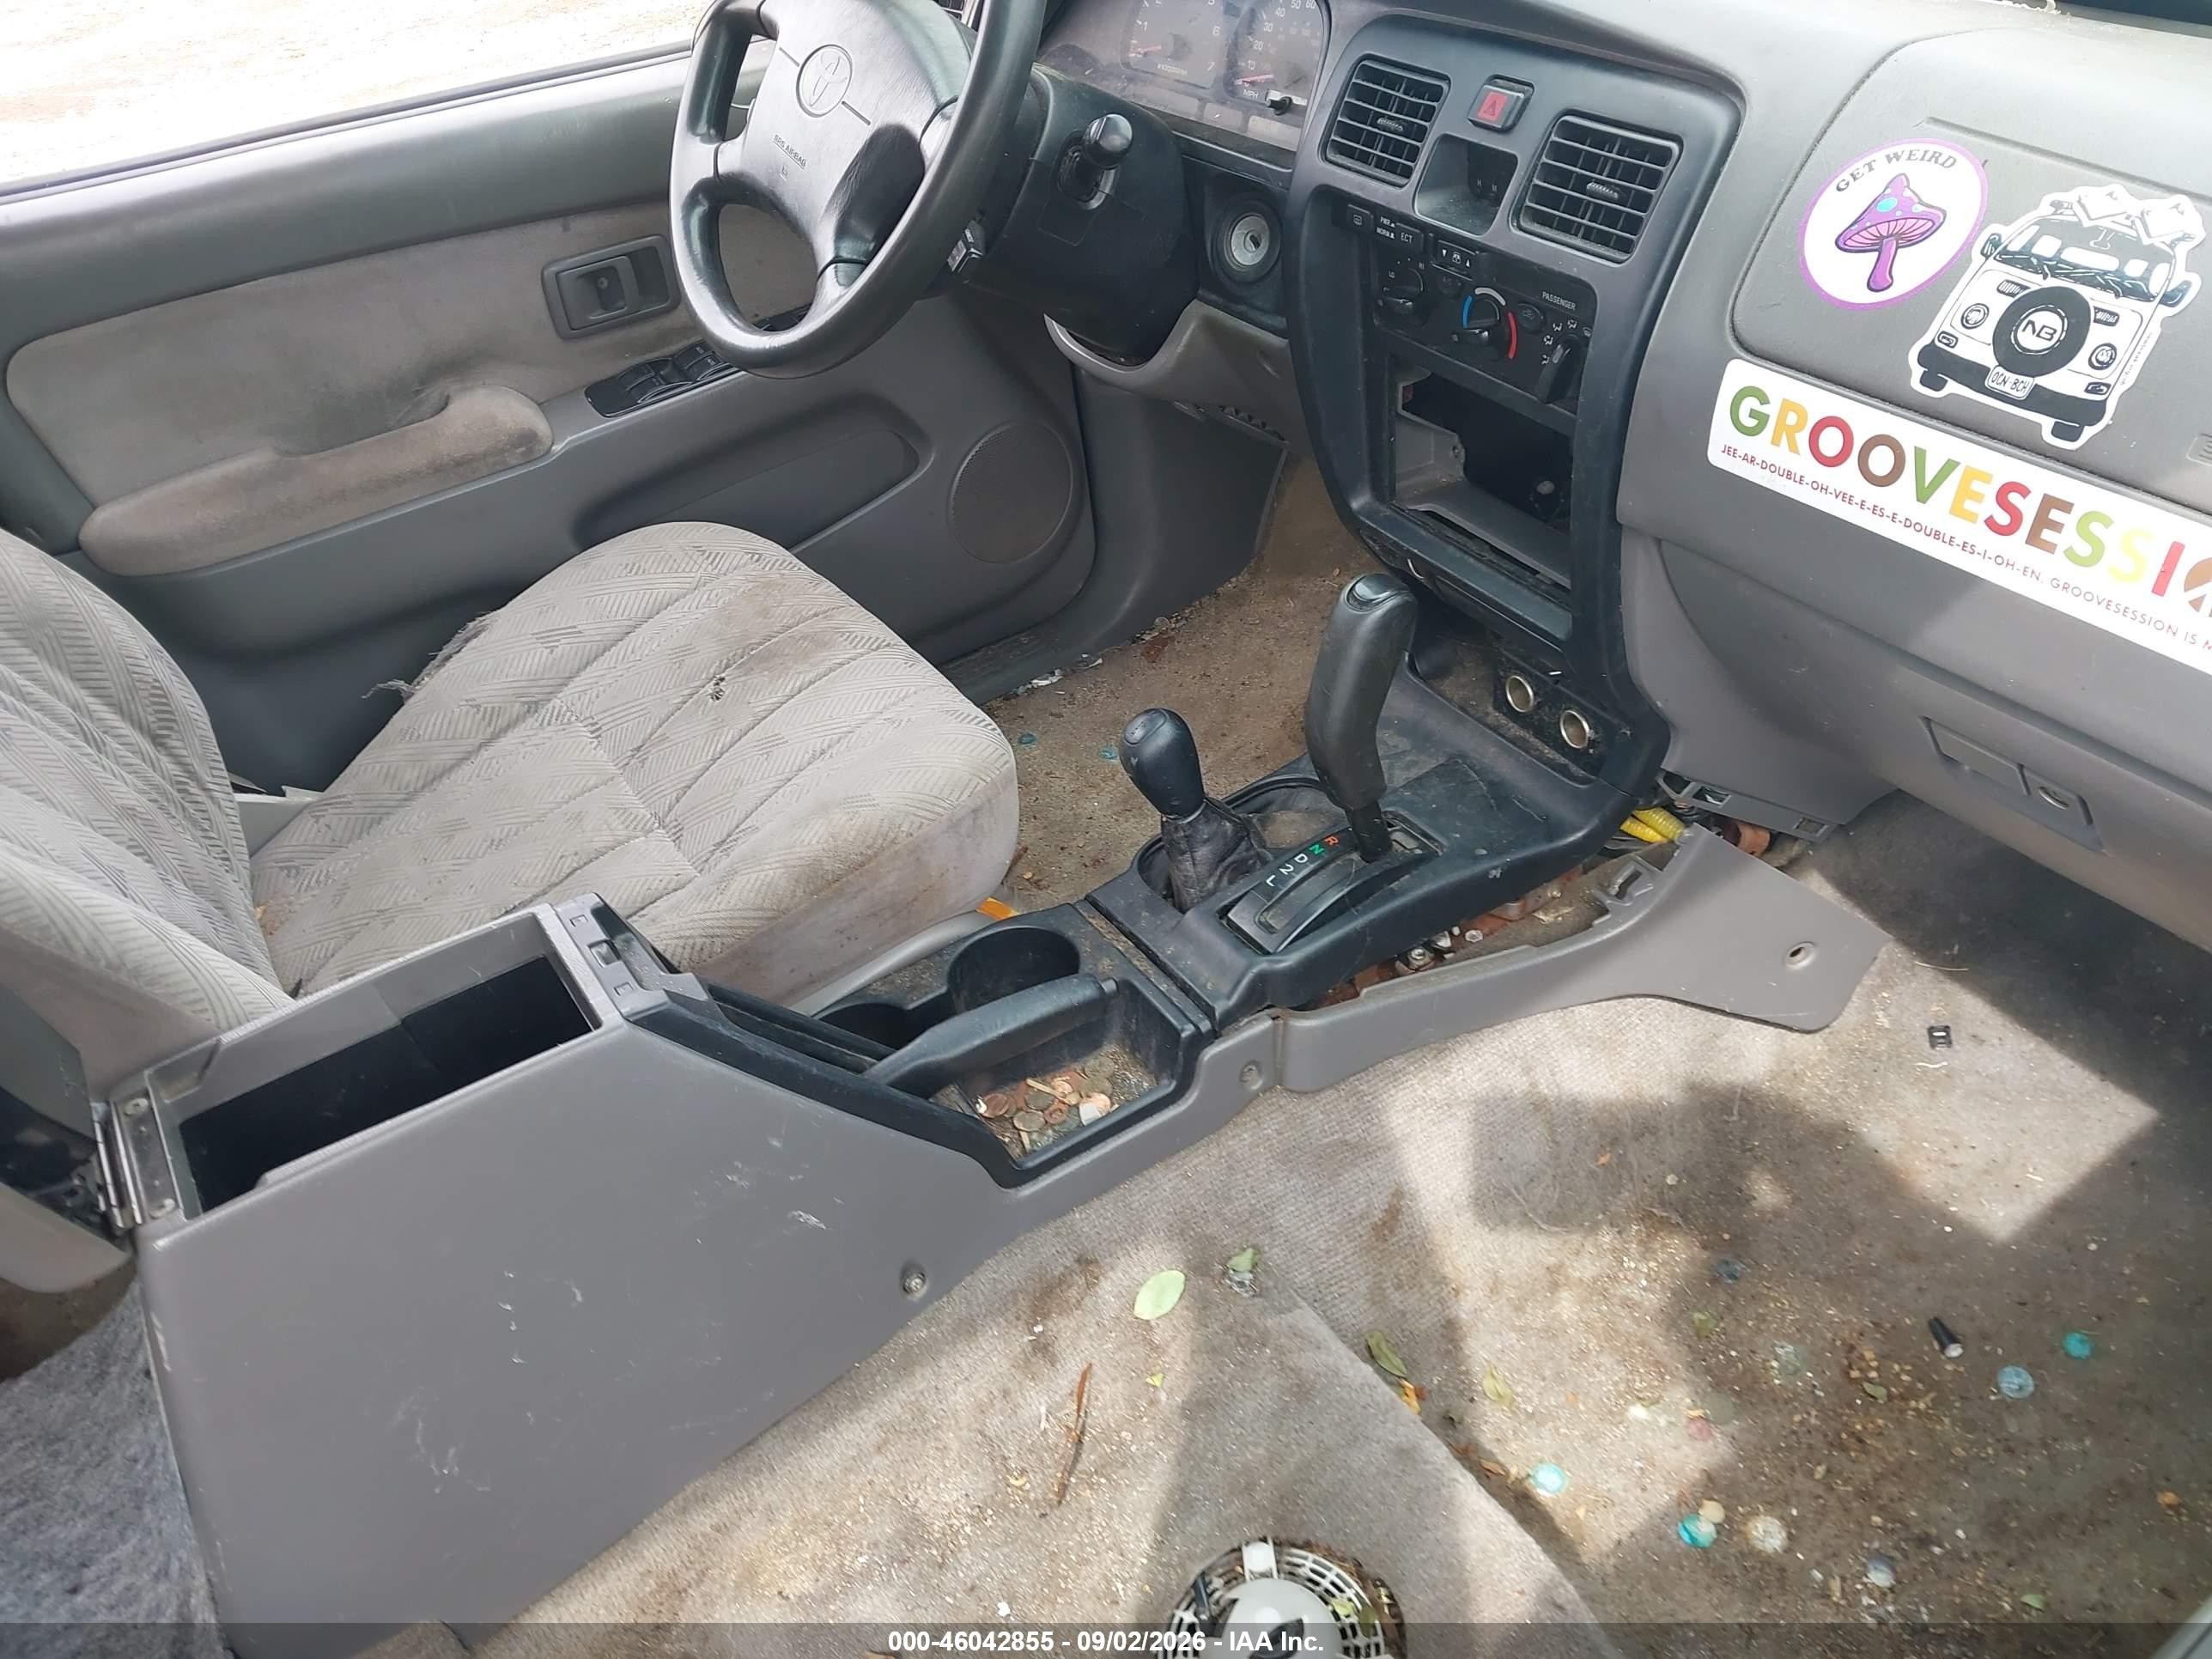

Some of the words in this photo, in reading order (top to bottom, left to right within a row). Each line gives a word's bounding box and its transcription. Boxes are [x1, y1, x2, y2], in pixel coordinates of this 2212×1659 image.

[1275, 7, 1285, 17] 40
[1212, 26, 1220, 35] 6
[1263, 21, 1273, 32] 30
[1254, 40, 1264, 50] 20
[1836, 160, 1876, 191] GET
[1885, 149, 1957, 169] WEIRD
[1401, 232, 1413, 243] ECT
[1542, 291, 1577, 311] PASSENGER
[2021, 319, 2057, 342] NB
[2050, 577, 2179, 637] GROOVESESSION
[2184, 631, 2198, 645] IS
[1323, 836, 1340, 847] R
[1309, 844, 1325, 855] N
[1294, 854, 1309, 865] D
[1279, 864, 1294, 875] 2
[1266, 874, 1277, 887] L
